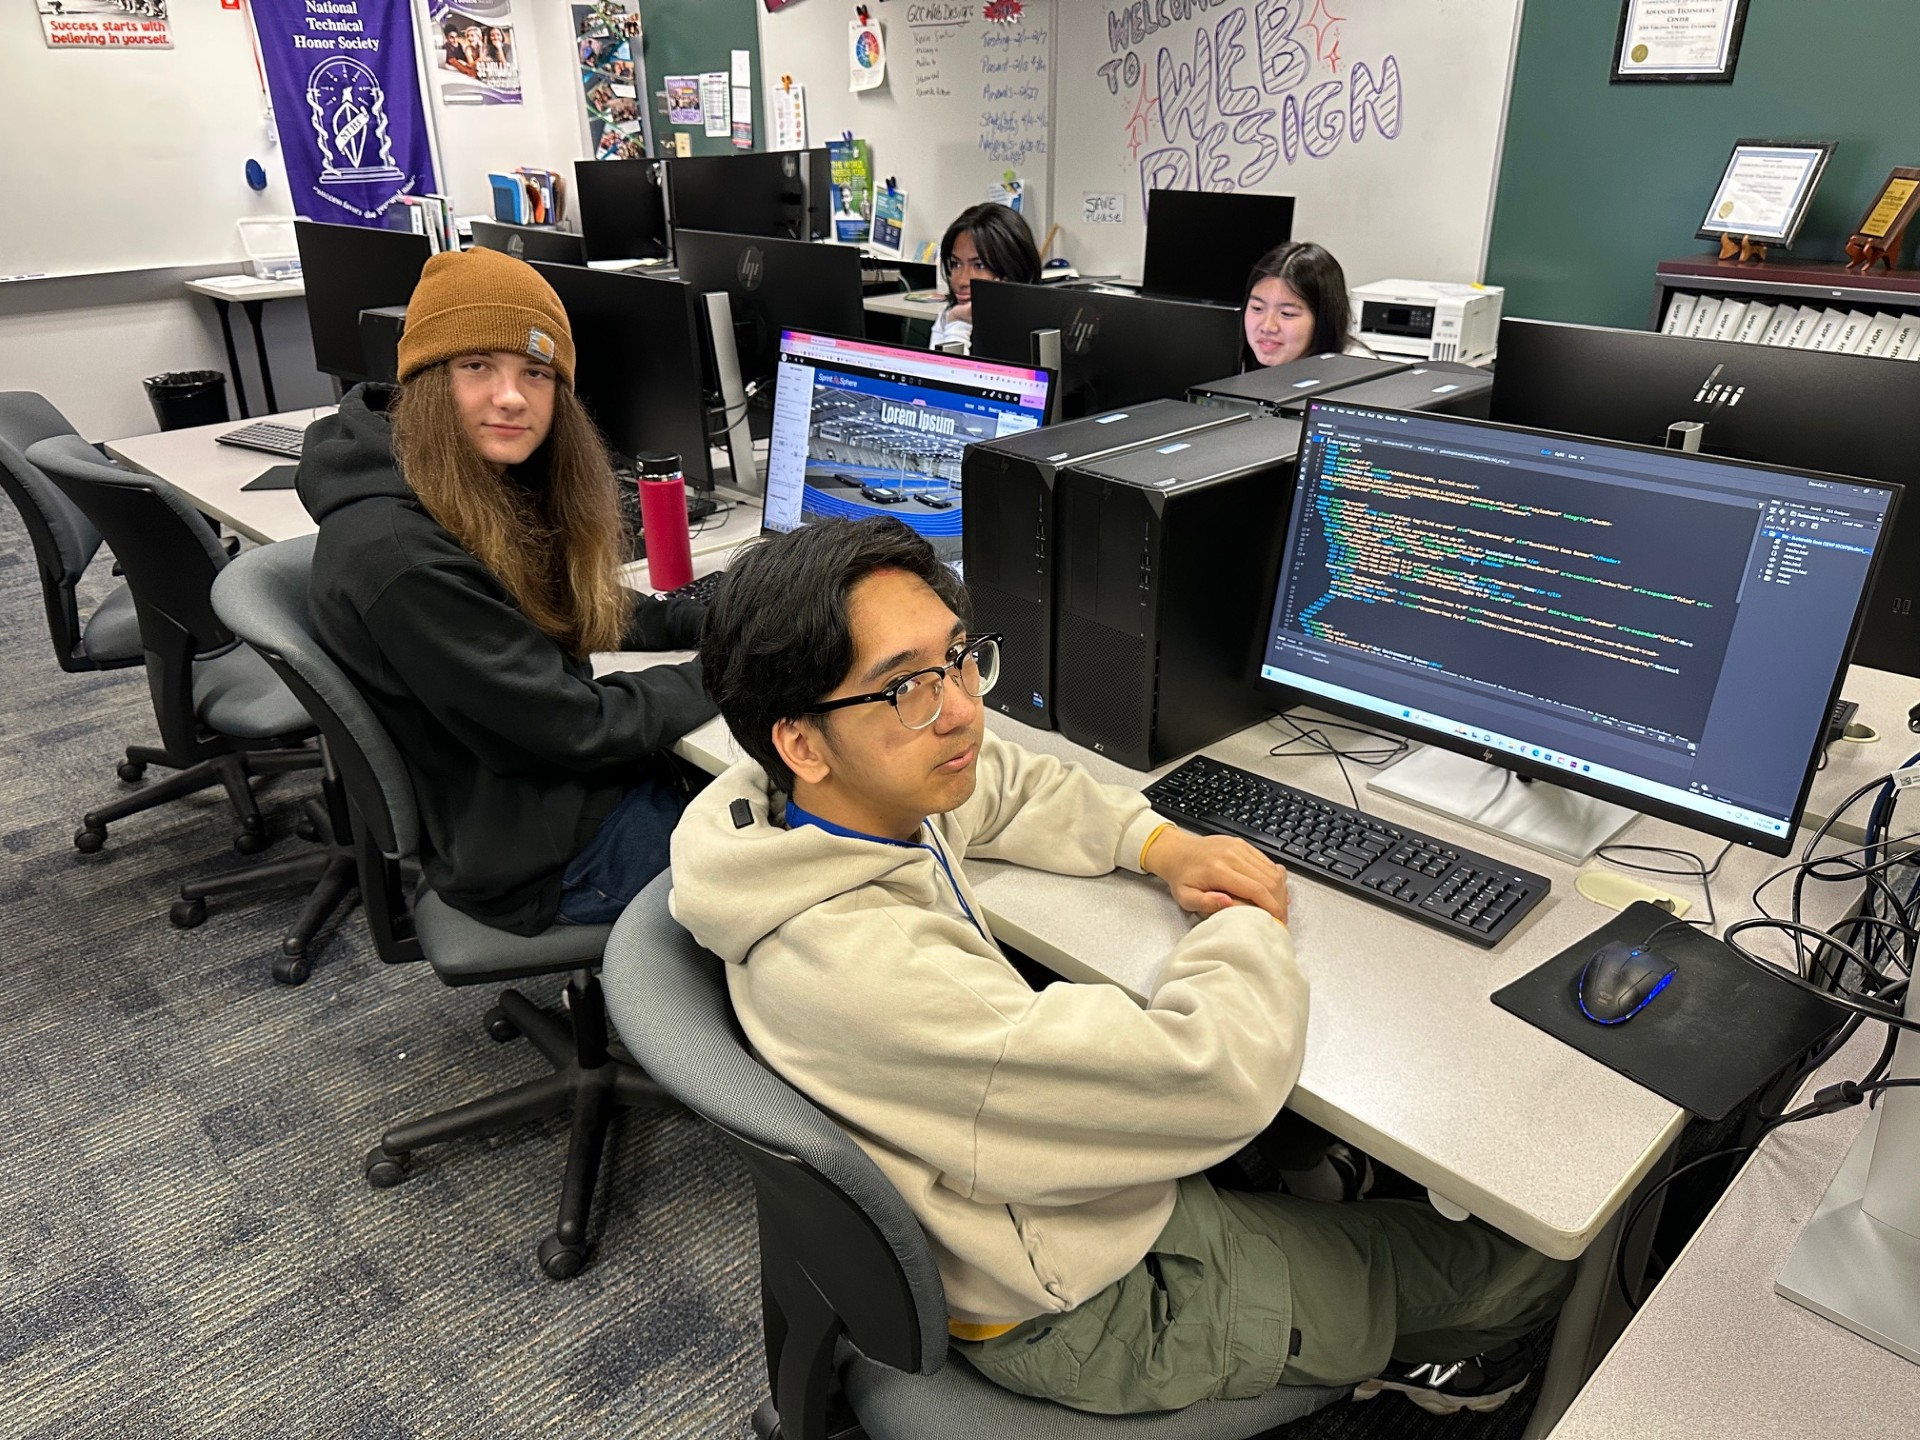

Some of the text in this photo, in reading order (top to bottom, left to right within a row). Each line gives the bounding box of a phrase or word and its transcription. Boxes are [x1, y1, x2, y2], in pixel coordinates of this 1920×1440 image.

[305, 0, 358, 14] National
[50, 21, 166, 31] Success starts with
[305, 17, 364, 32] Technical
[1107, 0, 1226, 53] WELCO
[51, 33, 170, 46] believing in yourself.
[293, 35, 379, 52] Honor Society
[1098, 52, 1140, 95] TO
[1157, 0, 1311, 144] WEB
[1140, 54, 1402, 227] DESIGN
[1795, 320, 1806, 335] WDF
[1821, 322, 1832, 338] WDF
[1845, 325, 1856, 340] WDF
[1898, 327, 1910, 344] WDF
[1871, 328, 1883, 345] WDF
[840, 378, 858, 388] Sphere
[881, 402, 955, 436] Lorem Ipsum
